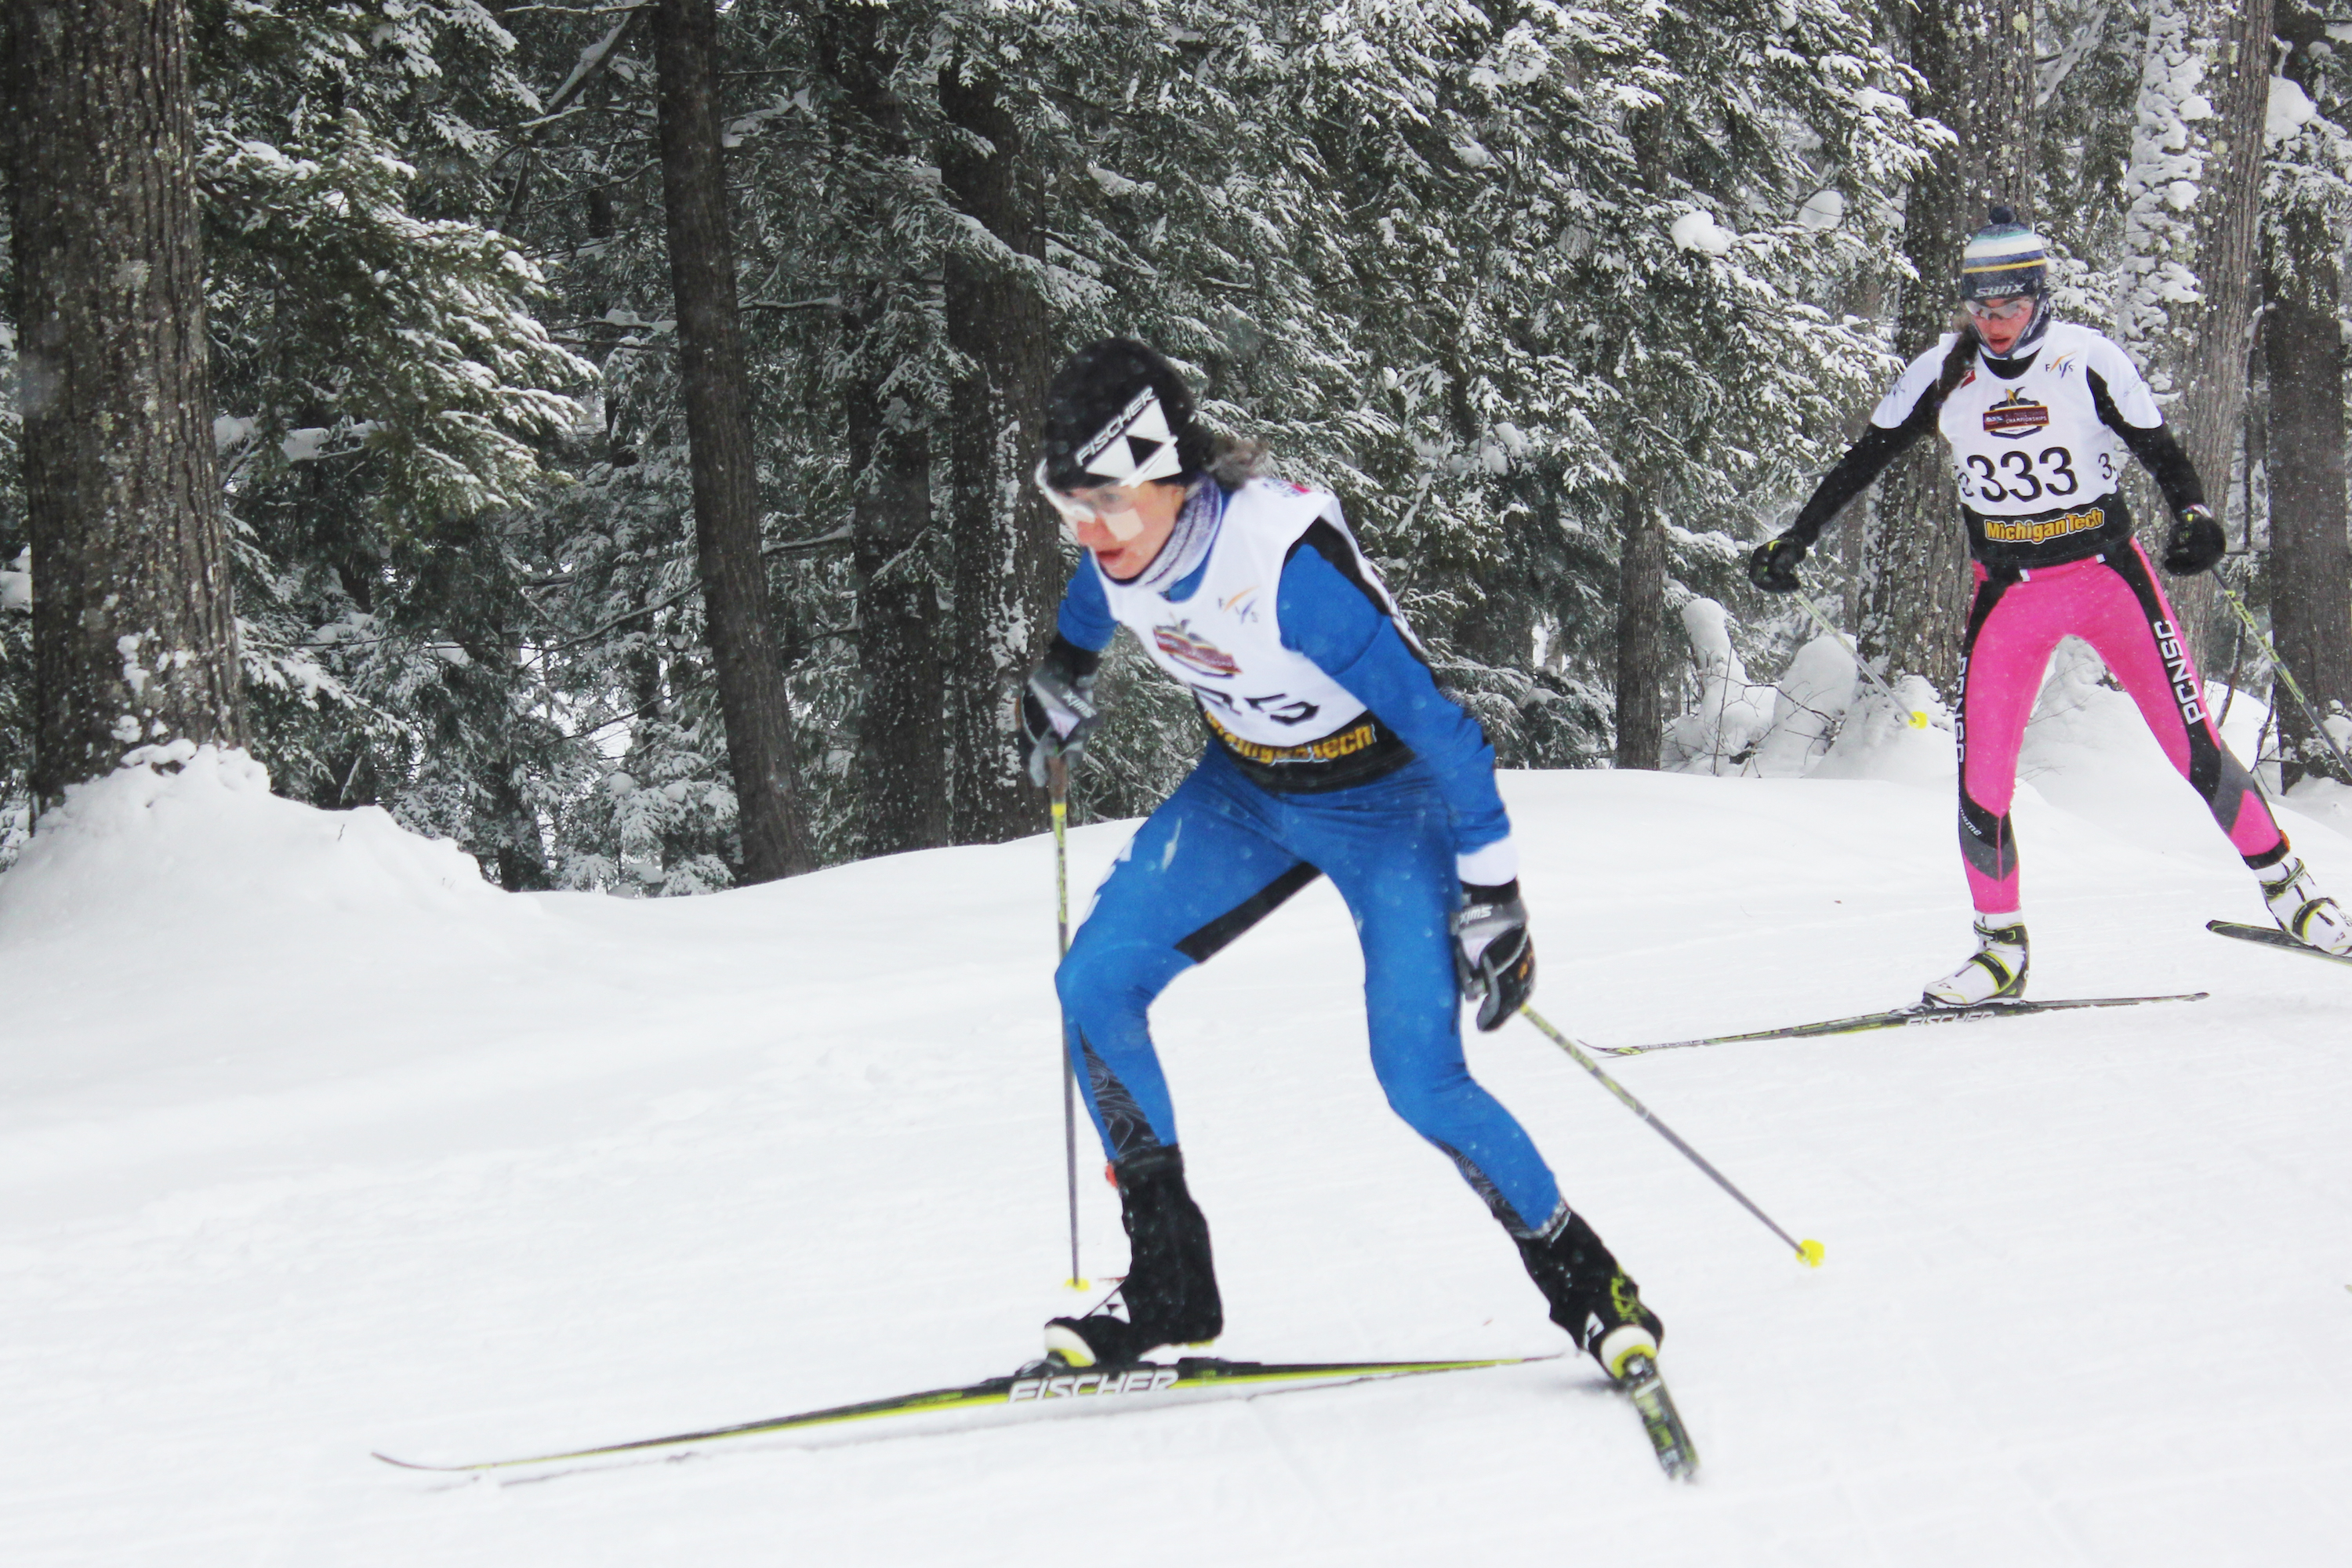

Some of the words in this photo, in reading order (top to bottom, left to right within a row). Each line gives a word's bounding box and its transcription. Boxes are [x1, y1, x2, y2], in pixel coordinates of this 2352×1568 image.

[1074, 385, 1156, 467] FISCHER
[1966, 446, 2078, 503] 333
[1985, 518, 2066, 543] Michigan
[2066, 508, 2104, 532] Tech
[2154, 619, 2207, 725] PCNSC
[1008, 1369, 1179, 1403] FISCHER
